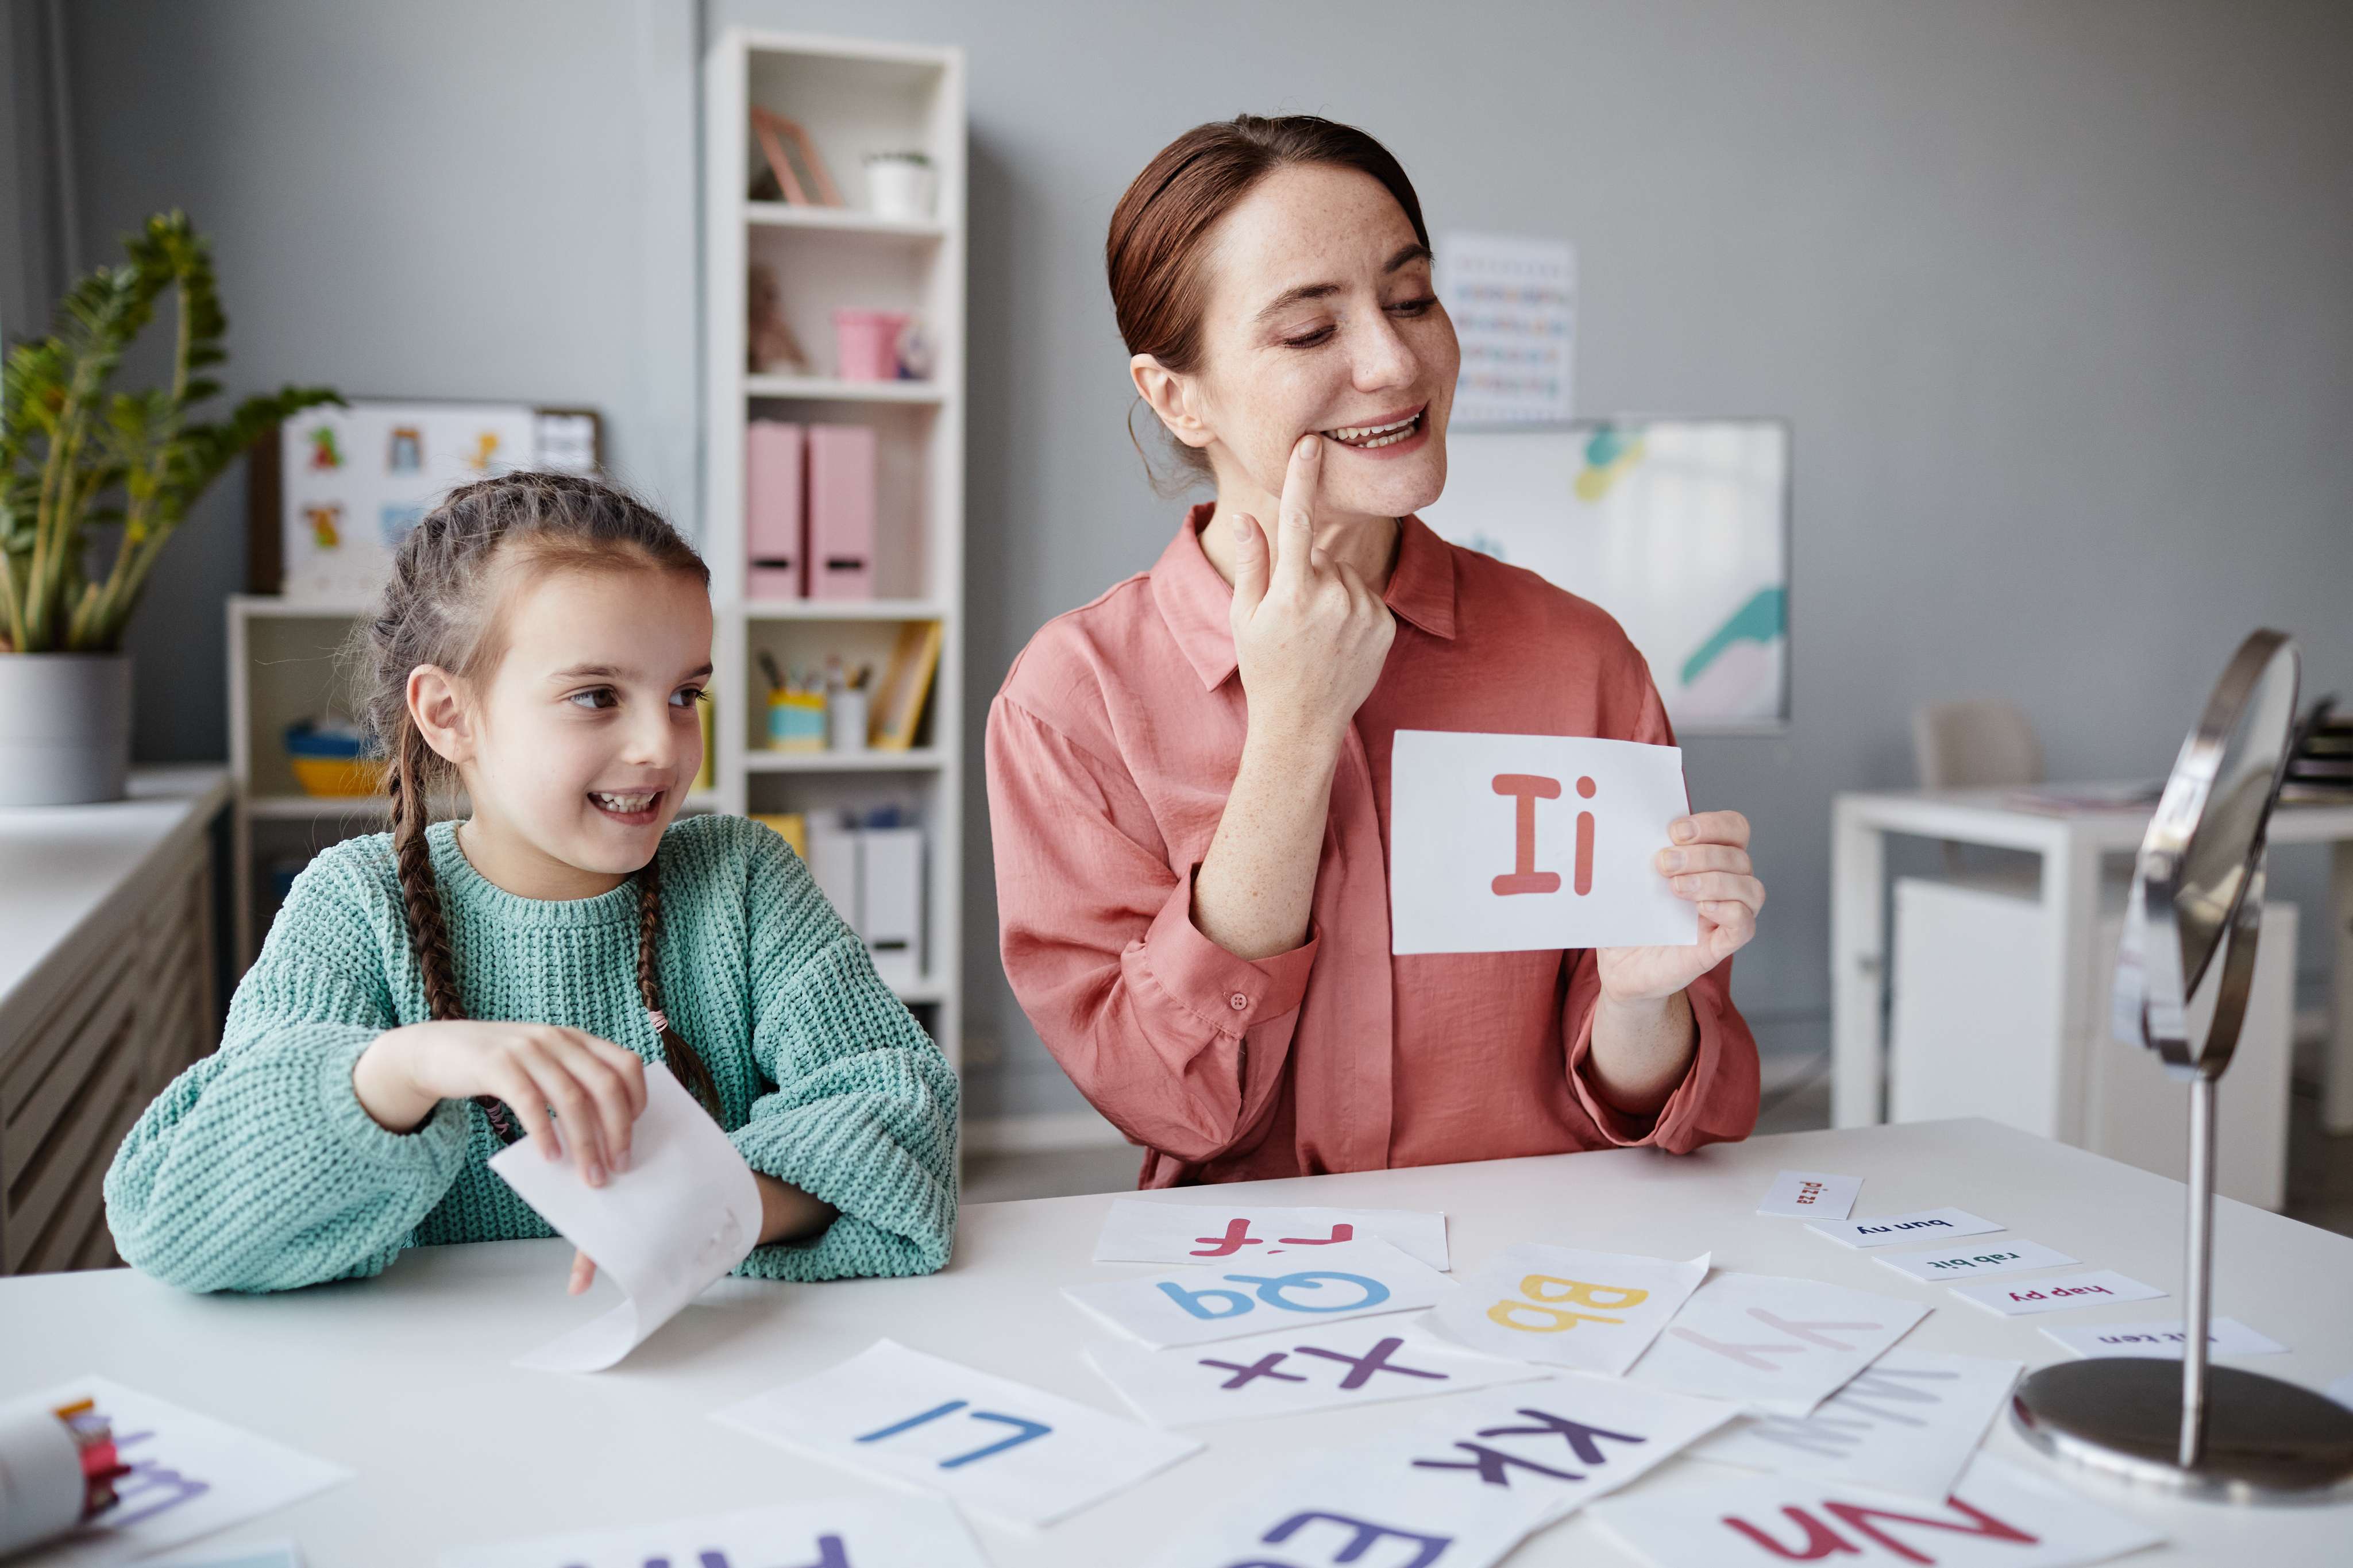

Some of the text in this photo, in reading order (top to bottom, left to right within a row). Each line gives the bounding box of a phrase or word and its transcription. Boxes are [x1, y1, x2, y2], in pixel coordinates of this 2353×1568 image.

[1491, 773, 1596, 896] Ii
[1856, 1219, 1954, 1234] bun ny
[1926, 1252, 2022, 1269] rab bit
[1156, 1271, 1390, 1320] Qq
[1486, 1273, 1649, 1333] Bb
[2008, 1285, 2115, 1301] hap py
[1198, 1337, 1449, 1390] Xx
[1411, 1409, 1648, 1489] Kk
[1722, 1496, 2039, 1567] Nn
